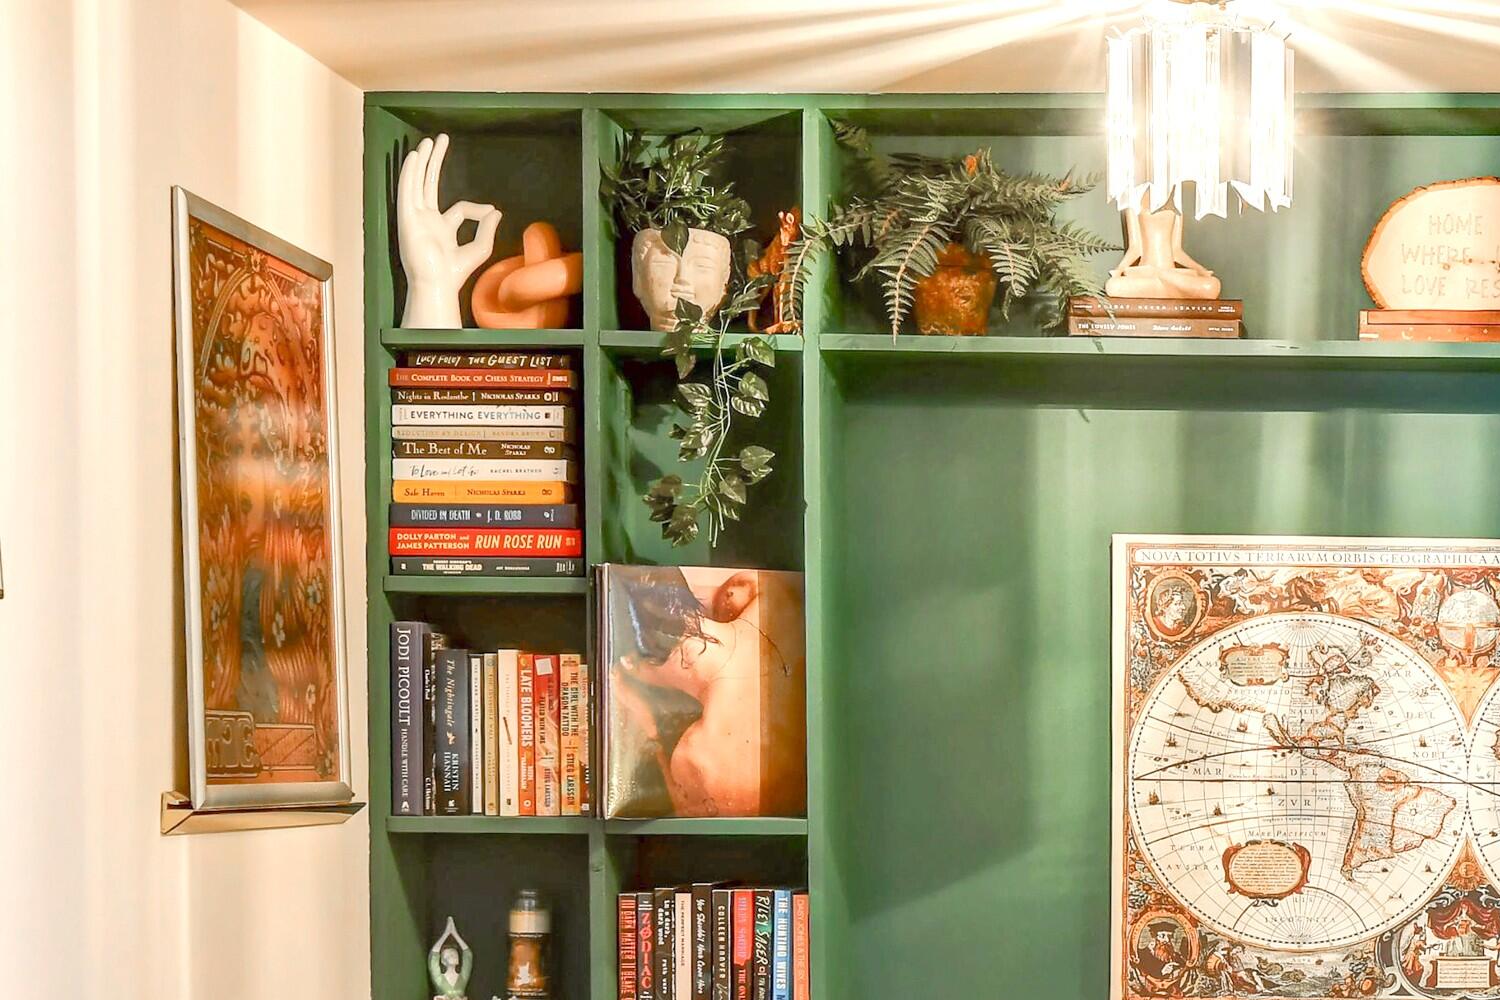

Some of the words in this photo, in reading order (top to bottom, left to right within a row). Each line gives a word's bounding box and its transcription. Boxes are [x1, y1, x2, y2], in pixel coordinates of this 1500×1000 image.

[1428, 214, 1483, 236] HOME
[1402, 243, 1471, 266] WHERE
[1402, 276, 1447, 297] LOVE
[468, 357, 485, 365] THE
[488, 355, 528, 367] GUEST
[530, 356, 553, 368] LIST
[411, 374, 449, 382] COMPLETE
[450, 374, 471, 382] BOOK
[484, 374, 508, 383] CHESS
[510, 374, 545, 383] STRATEGY
[410, 411, 474, 420] EVERYTHING
[478, 412, 541, 420] EVERYTHING
[403, 443, 425, 455] The
[427, 443, 452, 455] Best
[453, 443, 465, 455] of
[467, 443, 488, 456] Me
[411, 510, 438, 521] DIVIDED
[449, 510, 471, 521] DEATH
[474, 535, 500, 549] RUN
[504, 535, 534, 549] ROSE
[537, 535, 562, 549] RUN
[1140, 552, 1182, 562] NOVA
[1184, 552, 1240, 562] TOTIVS
[1246, 552, 1330, 563] TERRARVM
[1333, 553, 1375, 564] ORBIS
[397, 628, 412, 661] JODI
[446, 660, 455, 675] The
[1383, 670, 1412, 679] MAR
[521, 670, 532, 695] LATE
[571, 672, 579, 685] THE
[398, 666, 411, 726] PICOULT
[444, 678, 455, 727] Nightingale
[521, 696, 533, 748] BLOOMERS
[571, 705, 579, 723] WITH
[1407, 711, 1436, 720] DEL
[571, 725, 579, 737] THE
[451, 753, 459, 791] KRISTIN
[566, 753, 575, 773] STIEG
[1192, 768, 1223, 776] MAR
[1289, 768, 1318, 776] DEL
[567, 775, 575, 806] LARSSON
[1277, 799, 1312, 808] ZVR
[757, 896, 770, 926] RILEY
[778, 897, 788, 913] THE
[718, 905, 726, 942] COLLEEN
[756, 930, 770, 965] SAGER
[778, 918, 788, 958] HUNTING
[718, 944, 726, 980] HOOVER
[738, 969, 746, 984] THE
[777, 961, 787, 990] WIVES
